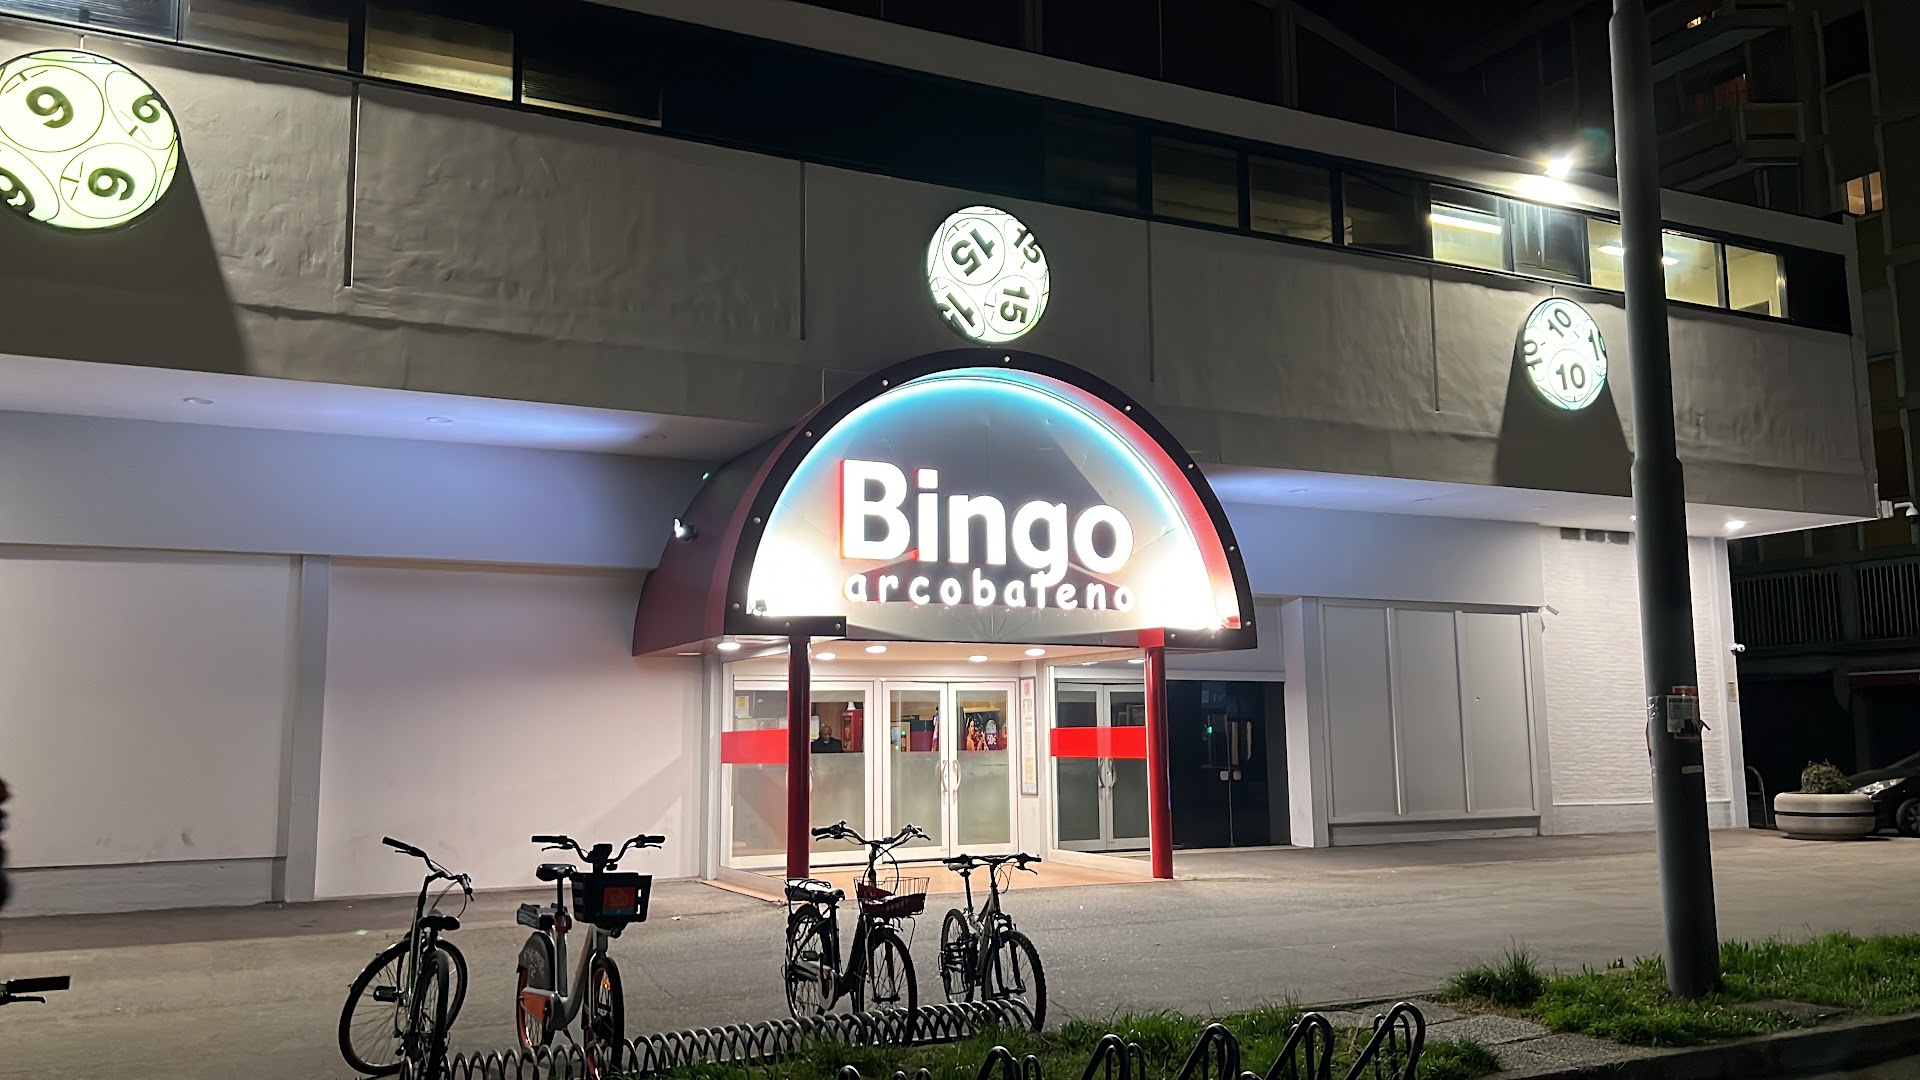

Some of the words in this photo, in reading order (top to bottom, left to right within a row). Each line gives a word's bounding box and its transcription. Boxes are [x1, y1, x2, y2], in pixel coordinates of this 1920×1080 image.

[951, 228, 995, 276] 15
[1000, 286, 1030, 324] 15
[1547, 308, 1572, 338] 10
[1556, 363, 1586, 390] 10
[841, 458, 1134, 587] Bingo
